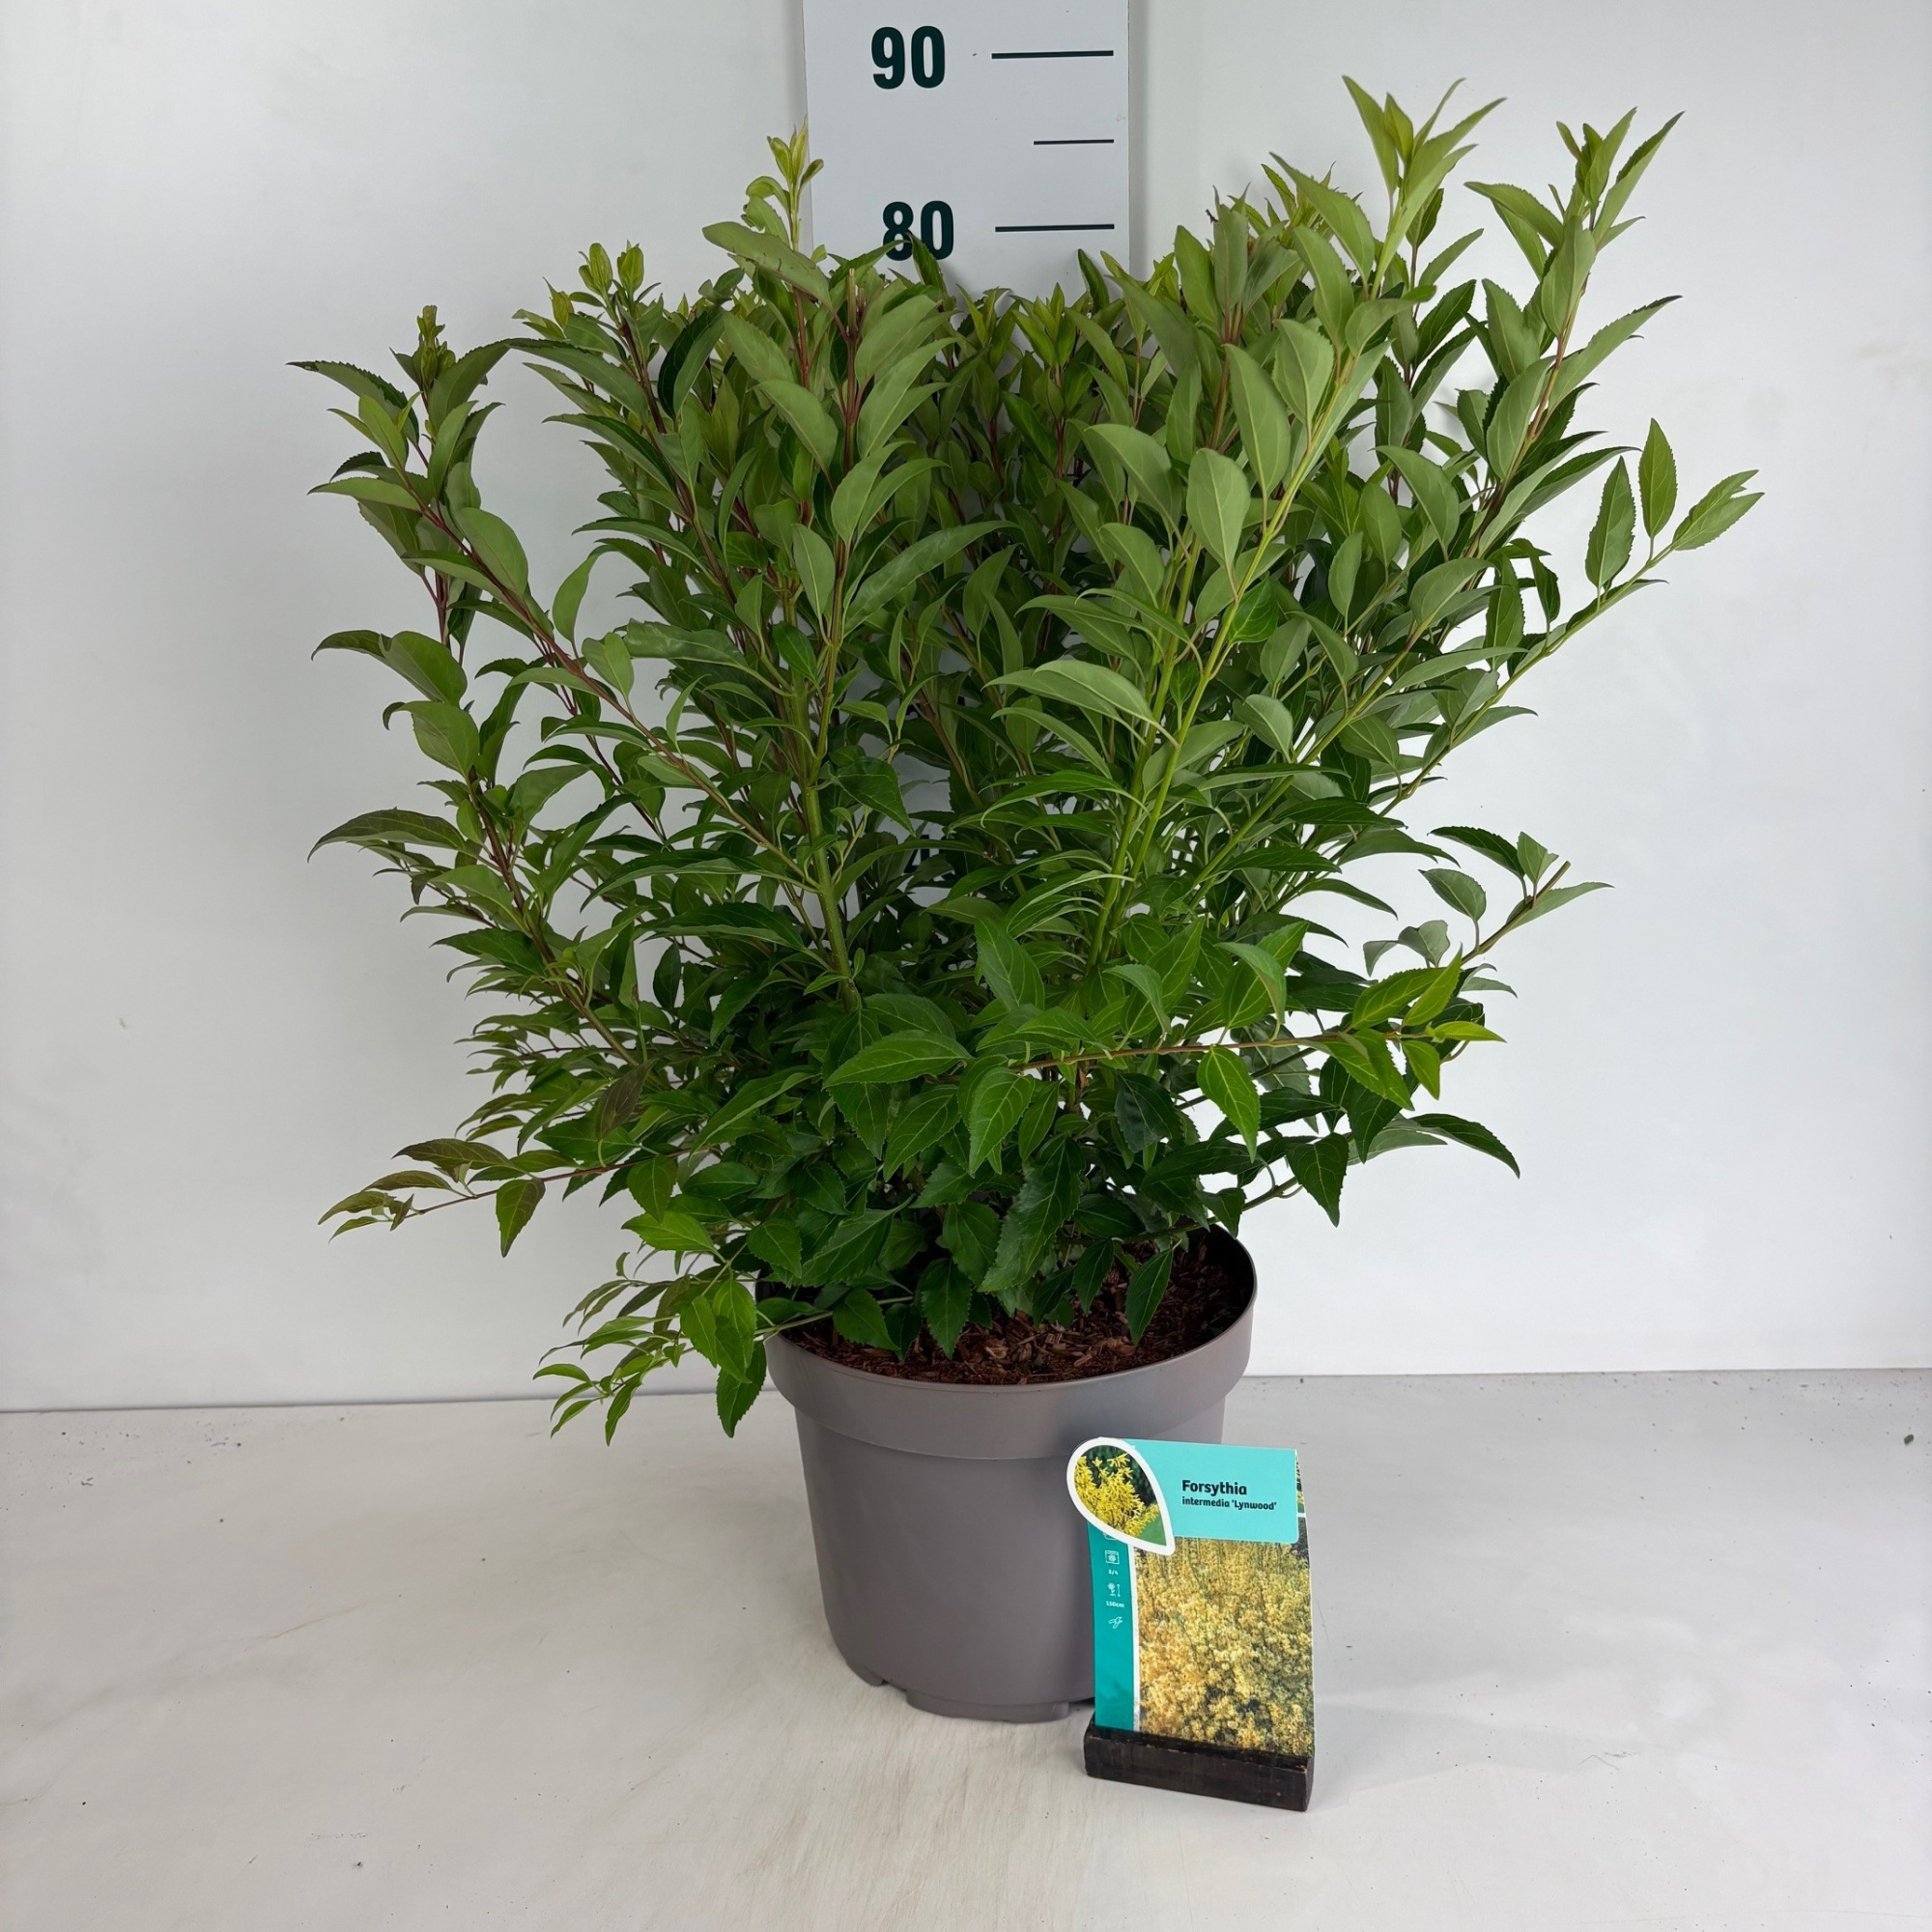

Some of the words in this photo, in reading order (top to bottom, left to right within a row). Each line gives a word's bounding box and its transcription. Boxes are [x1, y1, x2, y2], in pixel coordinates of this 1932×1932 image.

[870, 26, 946, 90] 90
[883, 200, 954, 262] 80
[1181, 1479, 1248, 1496] Forsythia
[1181, 1495, 1230, 1508] intermedia
